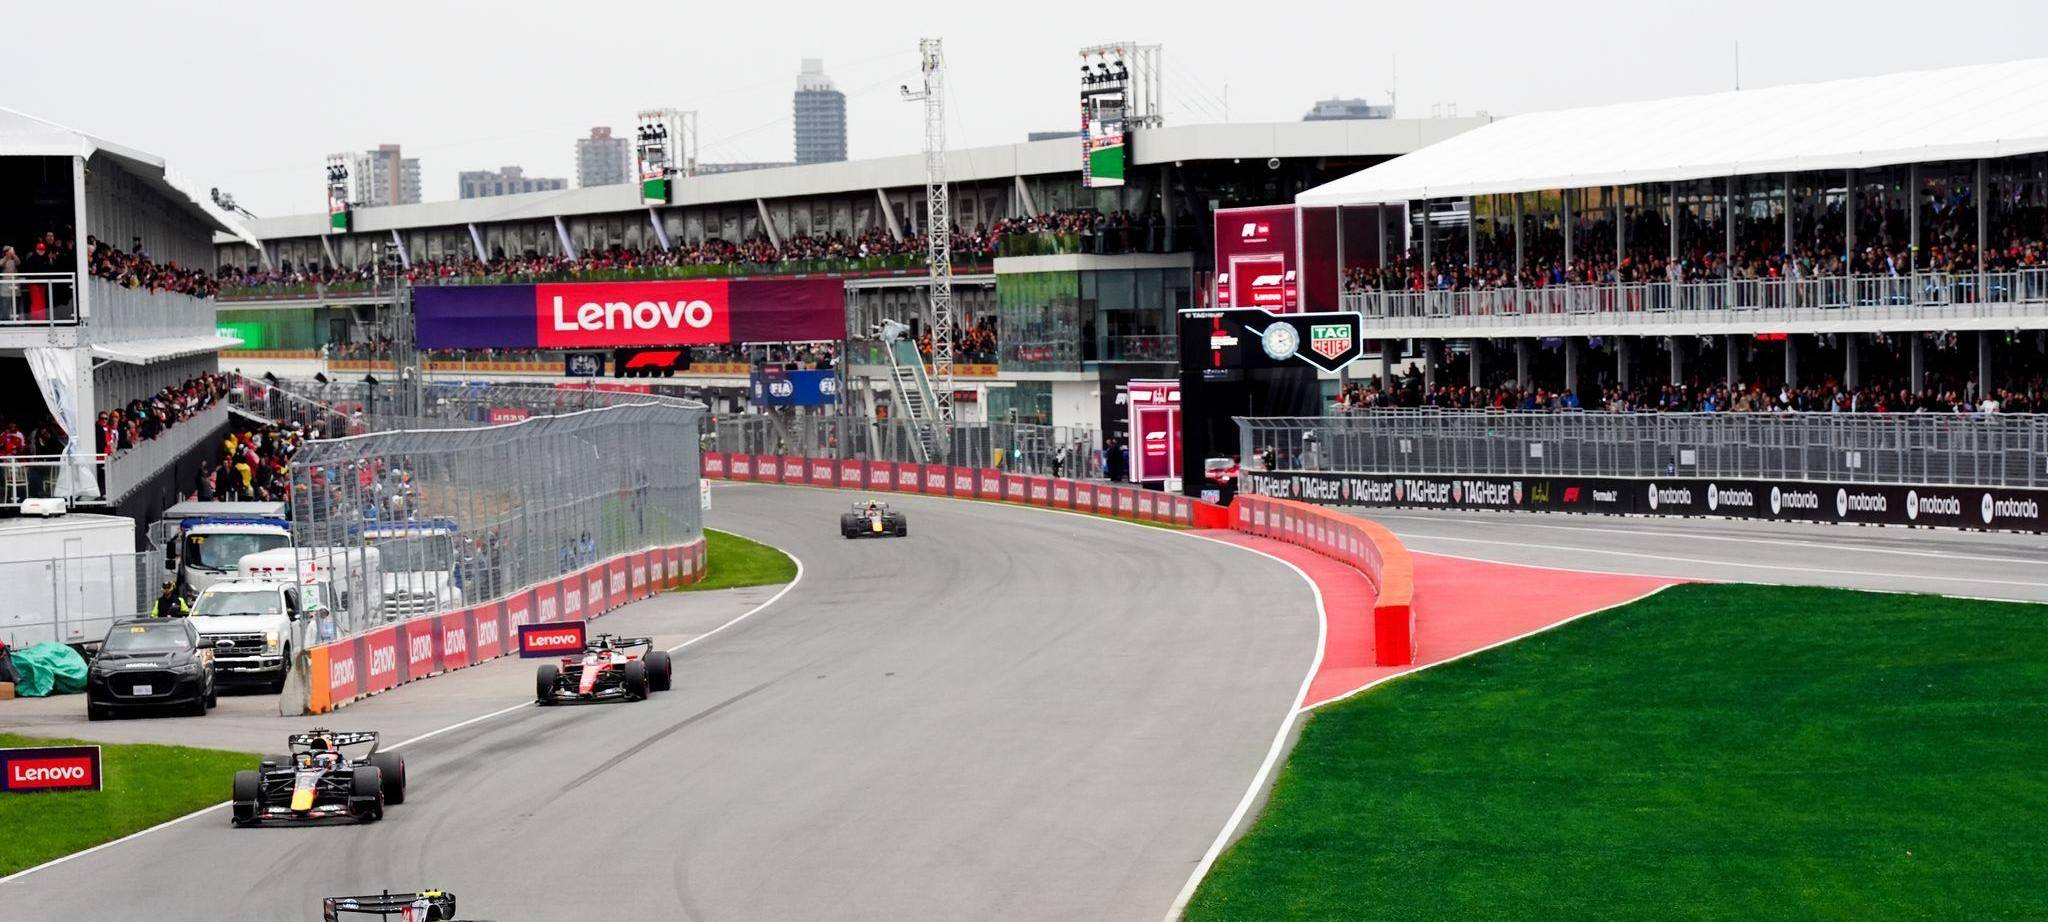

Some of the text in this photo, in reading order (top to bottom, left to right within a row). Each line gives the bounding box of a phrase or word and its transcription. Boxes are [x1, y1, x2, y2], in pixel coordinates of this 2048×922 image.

[553, 296, 713, 331] Lenovo
[1314, 327, 1348, 338] TAG
[1313, 340, 1350, 356] HEUER
[769, 381, 793, 395] FIA
[705, 456, 722, 472] Lenovo
[758, 459, 777, 476] Lenovo
[784, 461, 803, 478] Lenovo
[812, 463, 832, 480] Lenovo
[841, 465, 861, 482] Lenovo
[871, 467, 890, 484] Lenovo
[927, 470, 946, 489] Lenovo
[1300, 477, 1341, 499] TAGHeuer
[1350, 479, 1394, 502] TAGHeuer
[1405, 480, 1451, 503] TAGHeuer
[1463, 481, 1511, 504] TAGHeuer
[1658, 487, 2038, 518] motorola motorola motorola motorola motorola motorola
[330, 658, 355, 689] Lenovo
[369, 644, 396, 676] Lenovo
[408, 632, 432, 664] Lenovo
[443, 625, 466, 656] Lenovo
[476, 617, 498, 648] Lenovo
[508, 608, 529, 637] Lenovo
[538, 596, 556, 623] Lenovo
[528, 634, 577, 647] Lenovo
[15, 765, 85, 781] Lenovo
